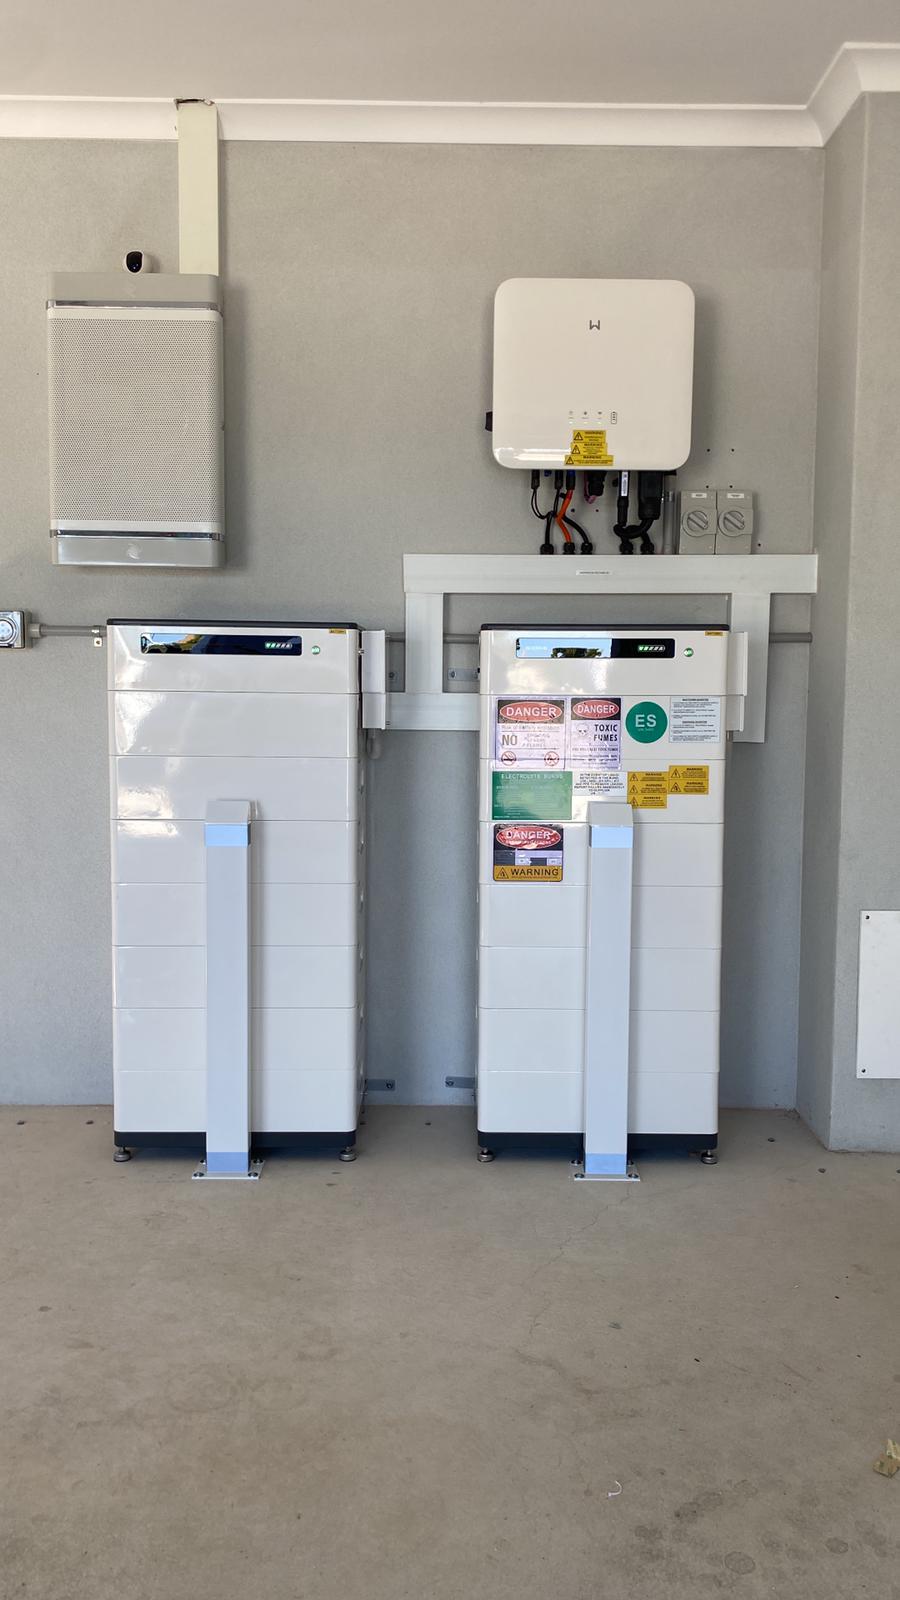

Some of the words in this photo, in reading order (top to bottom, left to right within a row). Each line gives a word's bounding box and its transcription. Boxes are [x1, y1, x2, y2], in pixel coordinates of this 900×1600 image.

[506, 706, 557, 717] DANGER
[577, 704, 615, 714] DANGER
[635, 714, 657, 728] ES
[594, 724, 618, 732] TOXIC
[501, 734, 518, 746] NO
[593, 734, 618, 742] FUMES
[506, 830, 551, 840] DANGER
[510, 868, 559, 876] WARNING
